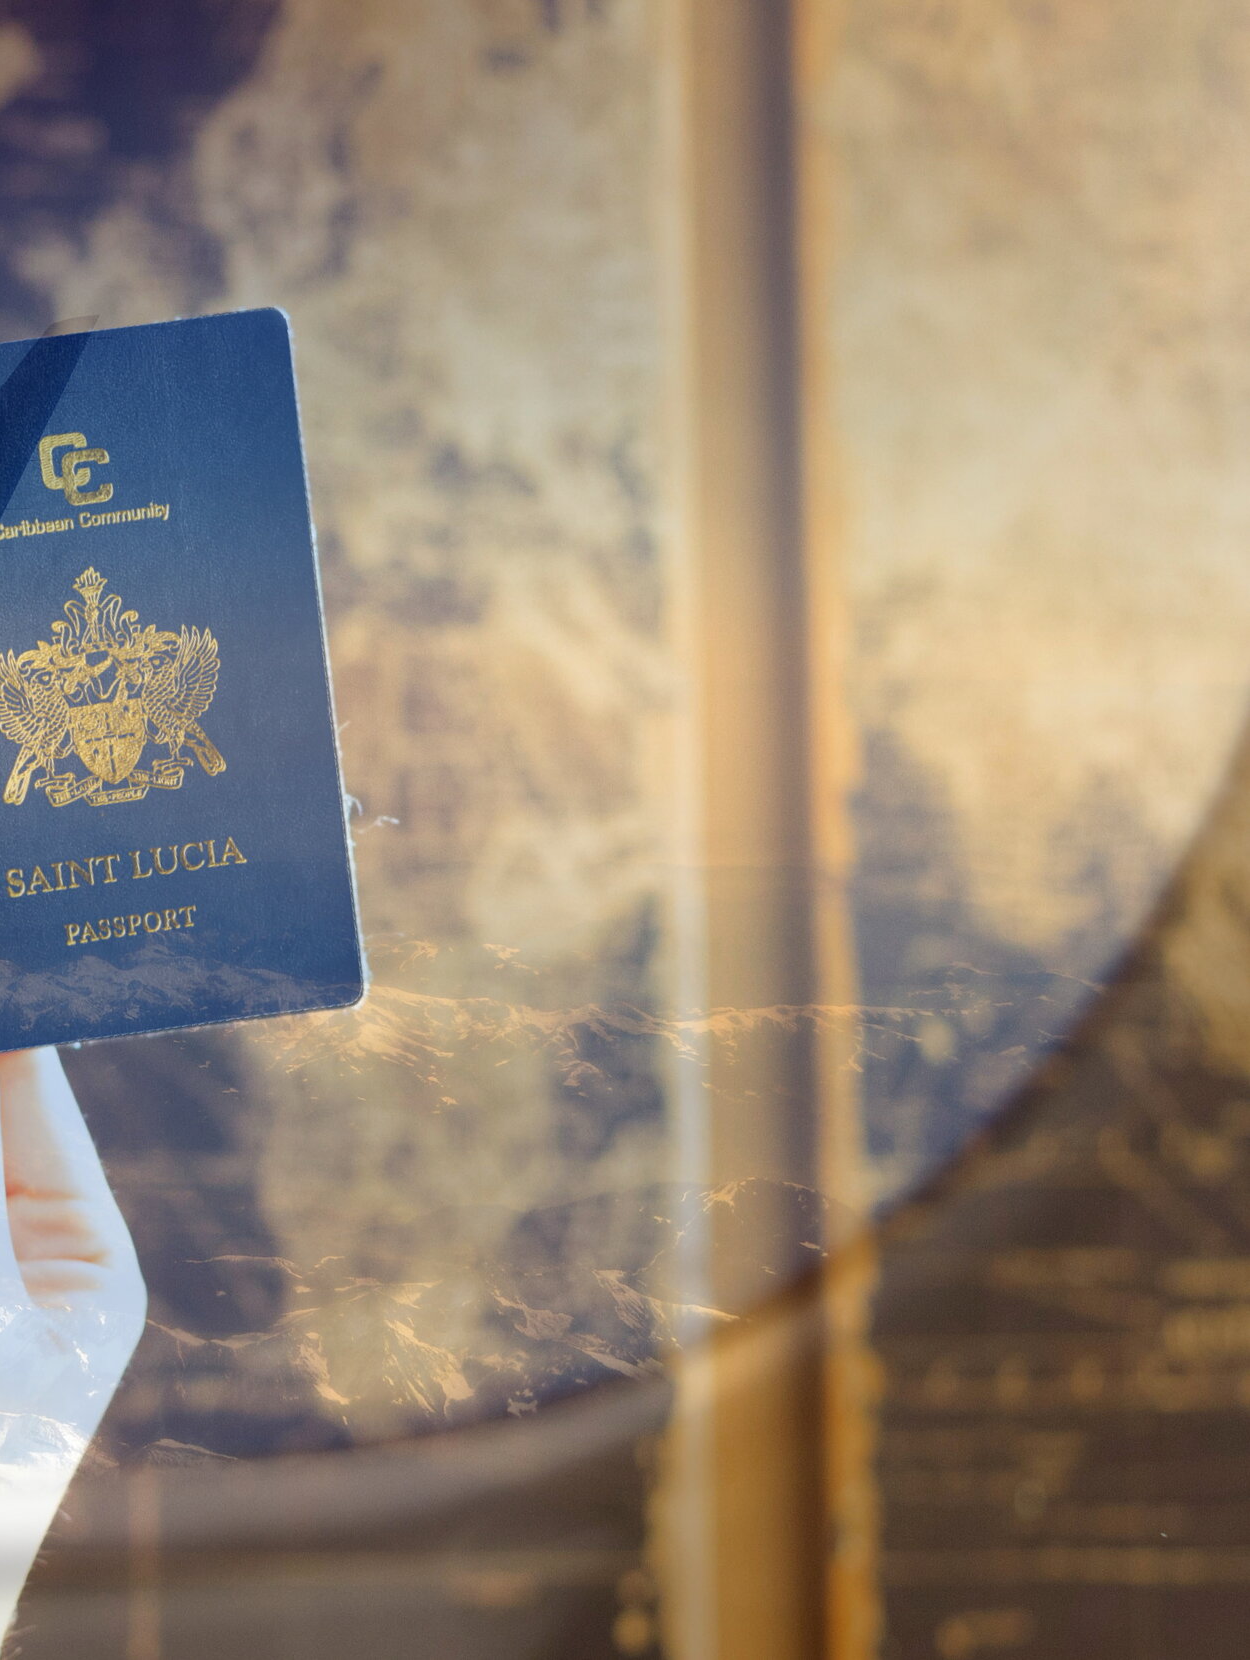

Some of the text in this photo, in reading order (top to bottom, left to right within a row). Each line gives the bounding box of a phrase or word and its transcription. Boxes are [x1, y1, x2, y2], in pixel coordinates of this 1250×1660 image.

[79, 501, 170, 528] Community
[5, 836, 248, 898] SAINT LUCIA
[64, 905, 197, 946] PASSPORT
